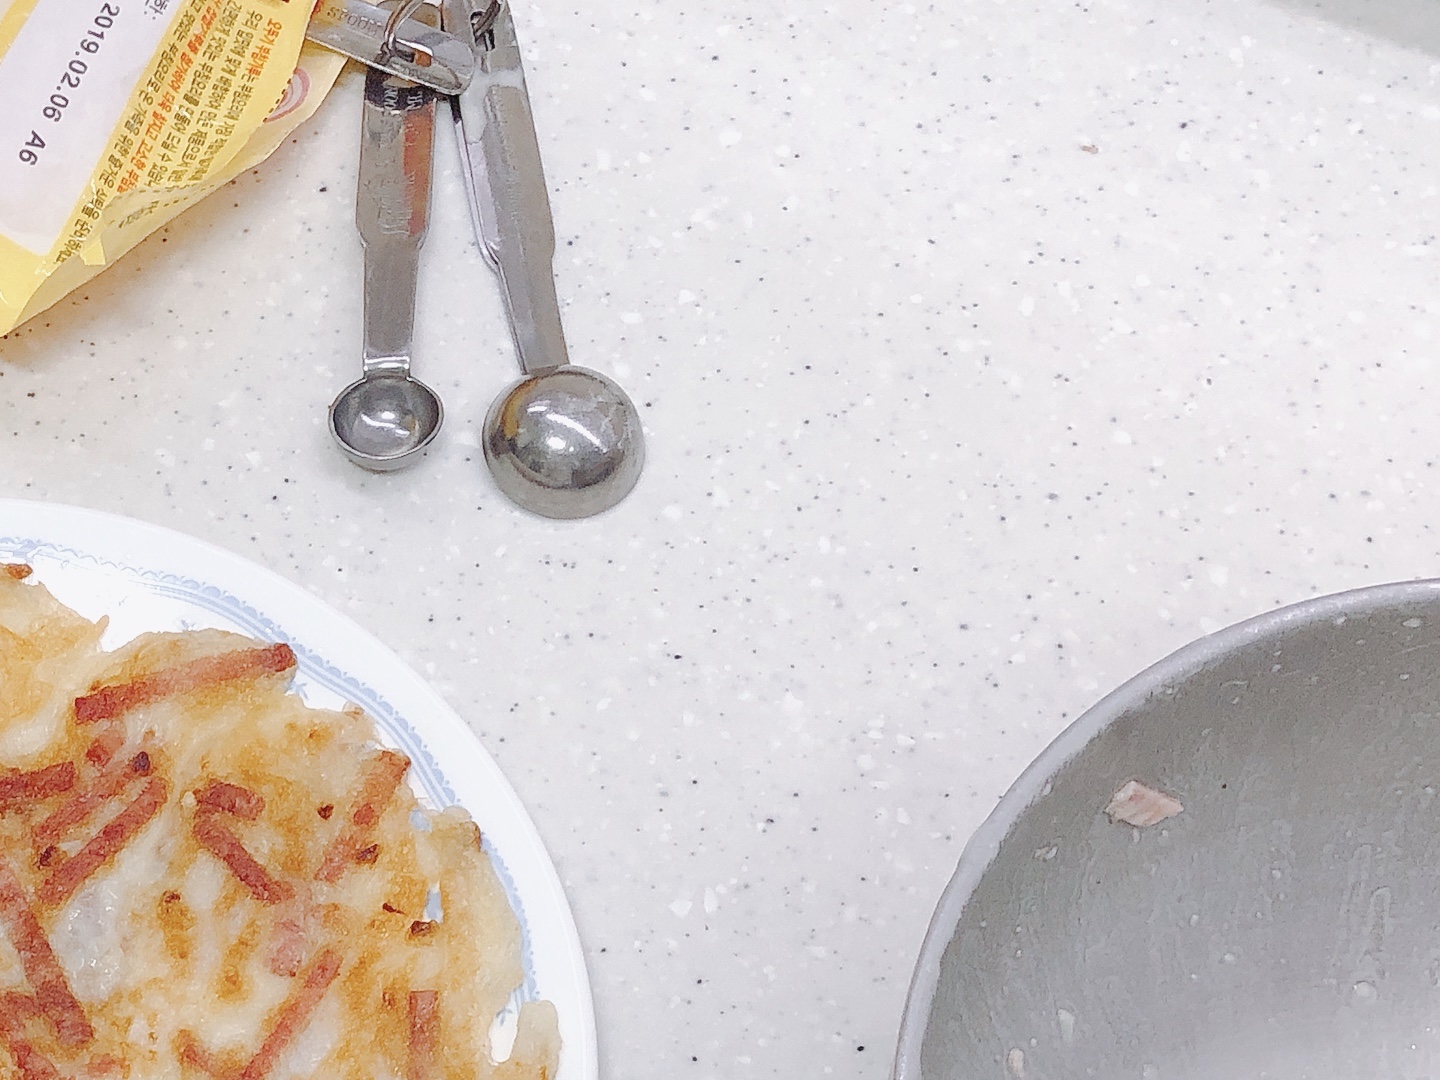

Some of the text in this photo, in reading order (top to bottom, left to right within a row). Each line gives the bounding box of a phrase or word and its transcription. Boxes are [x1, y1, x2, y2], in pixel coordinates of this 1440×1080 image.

[144, 0, 169, 20] 한:
[214, 0, 242, 36] 간편하게
[242, 10, 263, 30] 우리
[173, 10, 196, 42] 맛있는
[202, 35, 226, 62] 맛있는
[230, 30, 254, 58] 입맛에
[147, 43, 178, 93] 부침요리로
[168, 52, 193, 93] 첨가하여
[221, 56, 242, 76] 맞게
[241, 45, 270, 82] 부침가루는
[19, 3, 120, 165] 2019.02.06 A6
[139, 90, 153, 106] 온
[183, 62, 213, 106] 부침요리를
[206, 76, 232, 110] 배합하여
[158, 91, 175, 112] 더욱
[224, 84, 253, 120] 부침요리에
[124, 103, 148, 136] 가족을
[145, 111, 166, 141] 찰지고
[170, 104, 194, 134] 만들어
[196, 110, 217, 128] 만든
[216, 122, 235, 140] 가장
[114, 134, 133, 158] 위한
[131, 138, 153, 171] 고소한
[161, 132, 180, 153] 드실
[177, 129, 208, 171] 제품으로서
[99, 154, 124, 188] 즐거운
[157, 152, 173, 164] 수
